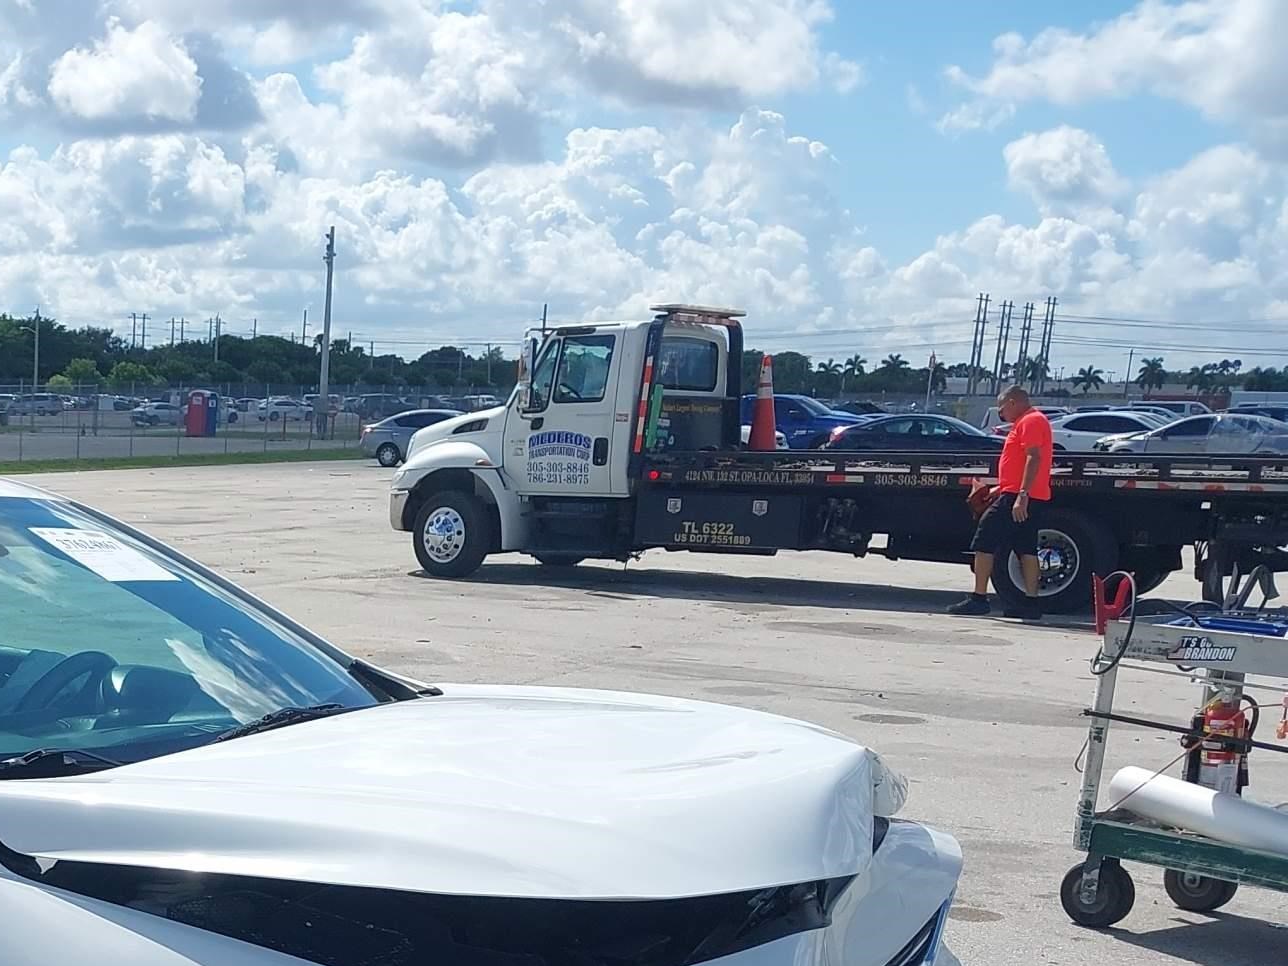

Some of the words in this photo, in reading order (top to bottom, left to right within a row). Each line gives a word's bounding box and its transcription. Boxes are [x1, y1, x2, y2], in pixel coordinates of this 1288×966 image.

[528, 430, 593, 449] MEDEROS
[526, 461, 590, 473] 305-303-8846
[874, 474, 948, 487] 305-303-8846
[682, 521, 699, 534] TL
[702, 522, 734, 535] 6322
[674, 532, 687, 543] US
[689, 534, 710, 544] DOT
[1183, 647, 1236, 661] BRANDON
